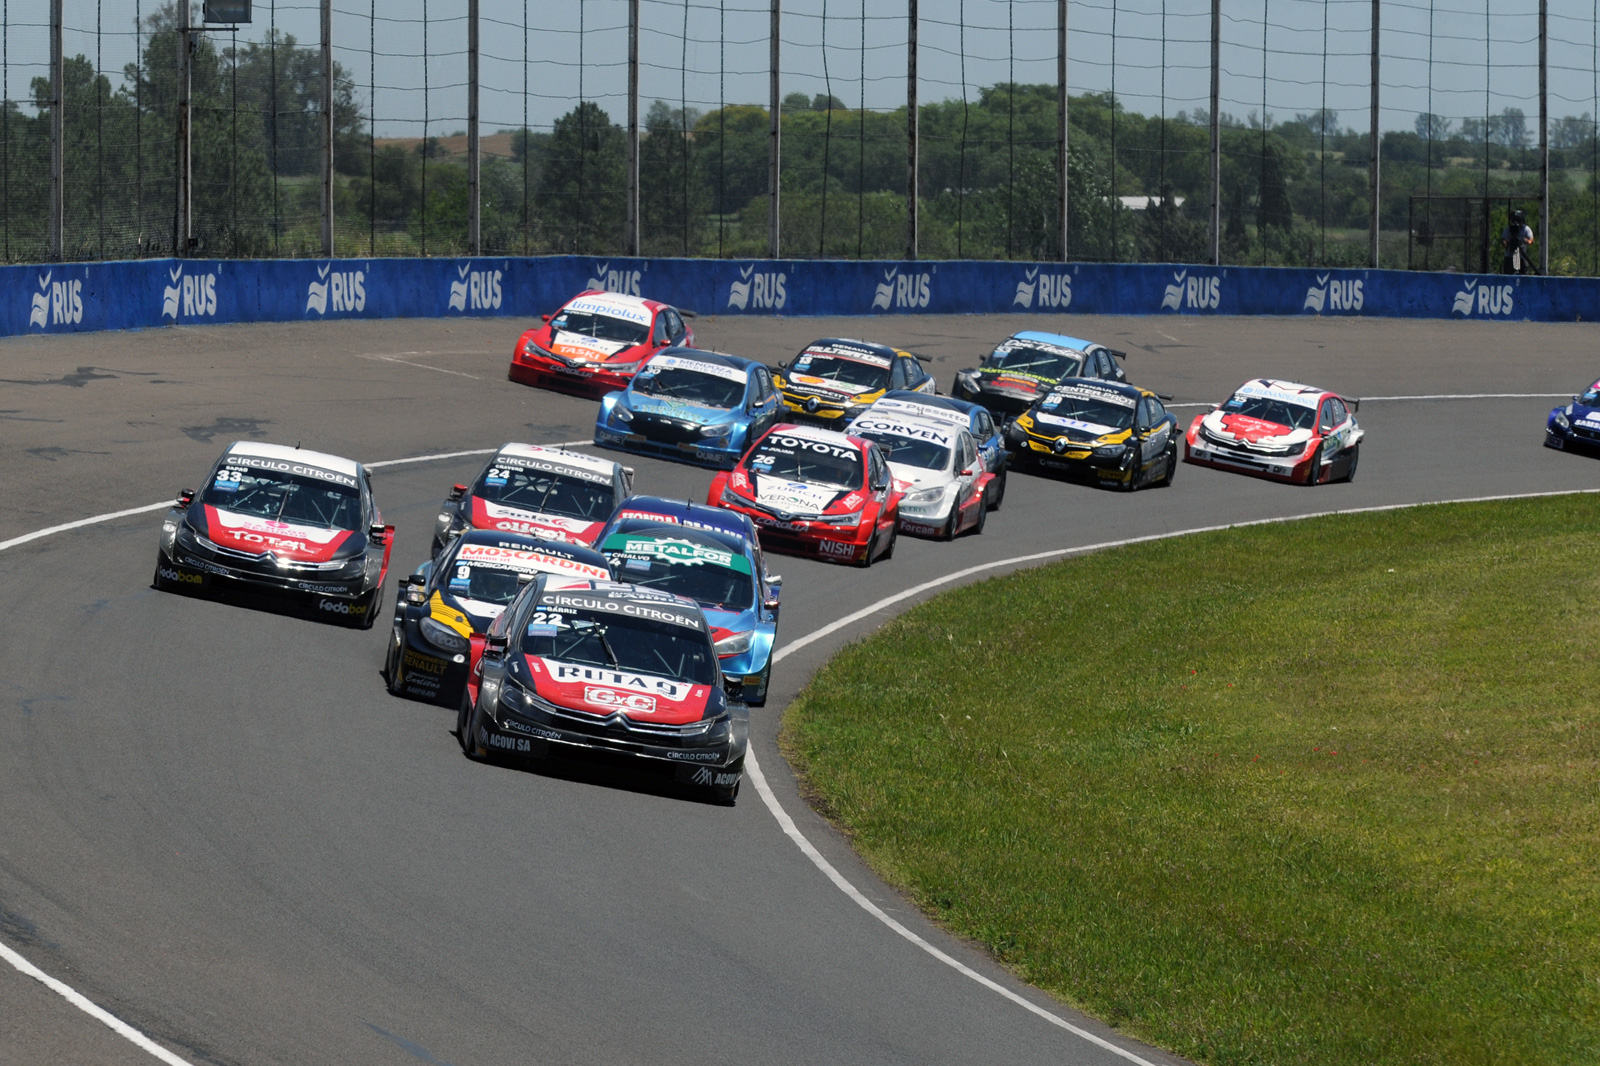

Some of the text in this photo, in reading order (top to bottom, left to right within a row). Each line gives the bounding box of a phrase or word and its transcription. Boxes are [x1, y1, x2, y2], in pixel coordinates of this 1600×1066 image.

[184, 273, 216, 316] RUS
[332, 271, 365, 312] RUS
[470, 270, 502, 309] RUS
[753, 273, 786, 309] RUS
[897, 273, 930, 308] RUS
[1039, 274, 1071, 308] RUS
[1187, 276, 1220, 309] RUS
[1330, 279, 1363, 311] RUS
[1478, 285, 1513, 315] RUS
[52, 279, 83, 325] RUS
[572, 301, 646, 322] limpiolux
[560, 346, 600, 360] TASKI
[832, 344, 875, 355] RENAULT
[549, 364, 594, 378] COROLLA
[679, 359, 733, 374] MENDOZA
[1044, 395, 1063, 404] 90
[1054, 385, 1102, 396] CENTER
[1103, 392, 1136, 406] PROT
[1077, 383, 1120, 395] RENAULT
[855, 420, 949, 445] CORVEN
[768, 435, 858, 462] TOYOTA
[752, 455, 776, 464] 26
[216, 470, 243, 483] 33
[227, 456, 356, 486] CÍRCULO CITROËN
[488, 468, 510, 479] 24
[497, 456, 611, 485] CÍRCULO CITROËN
[759, 493, 819, 511] VERONA
[755, 517, 810, 532] COROLLA
[900, 521, 935, 535] Forcam
[228, 530, 322, 554] TOTAL
[498, 541, 574, 559] RENAULT
[819, 540, 855, 556] NISHI
[462, 546, 606, 579] MOSCARDINI
[612, 552, 650, 561] CHIALVO
[625, 543, 732, 564] METALFOR
[457, 566, 471, 579] 9
[467, 561, 538, 574] MOSCARDINI
[532, 612, 565, 625] 22
[543, 594, 619, 611] CÍRCULO
[622, 605, 699, 628] CITROËN
[404, 656, 448, 675] RENAULT
[559, 667, 648, 688] RUTA
[490, 734, 530, 751] ACOVI SA
